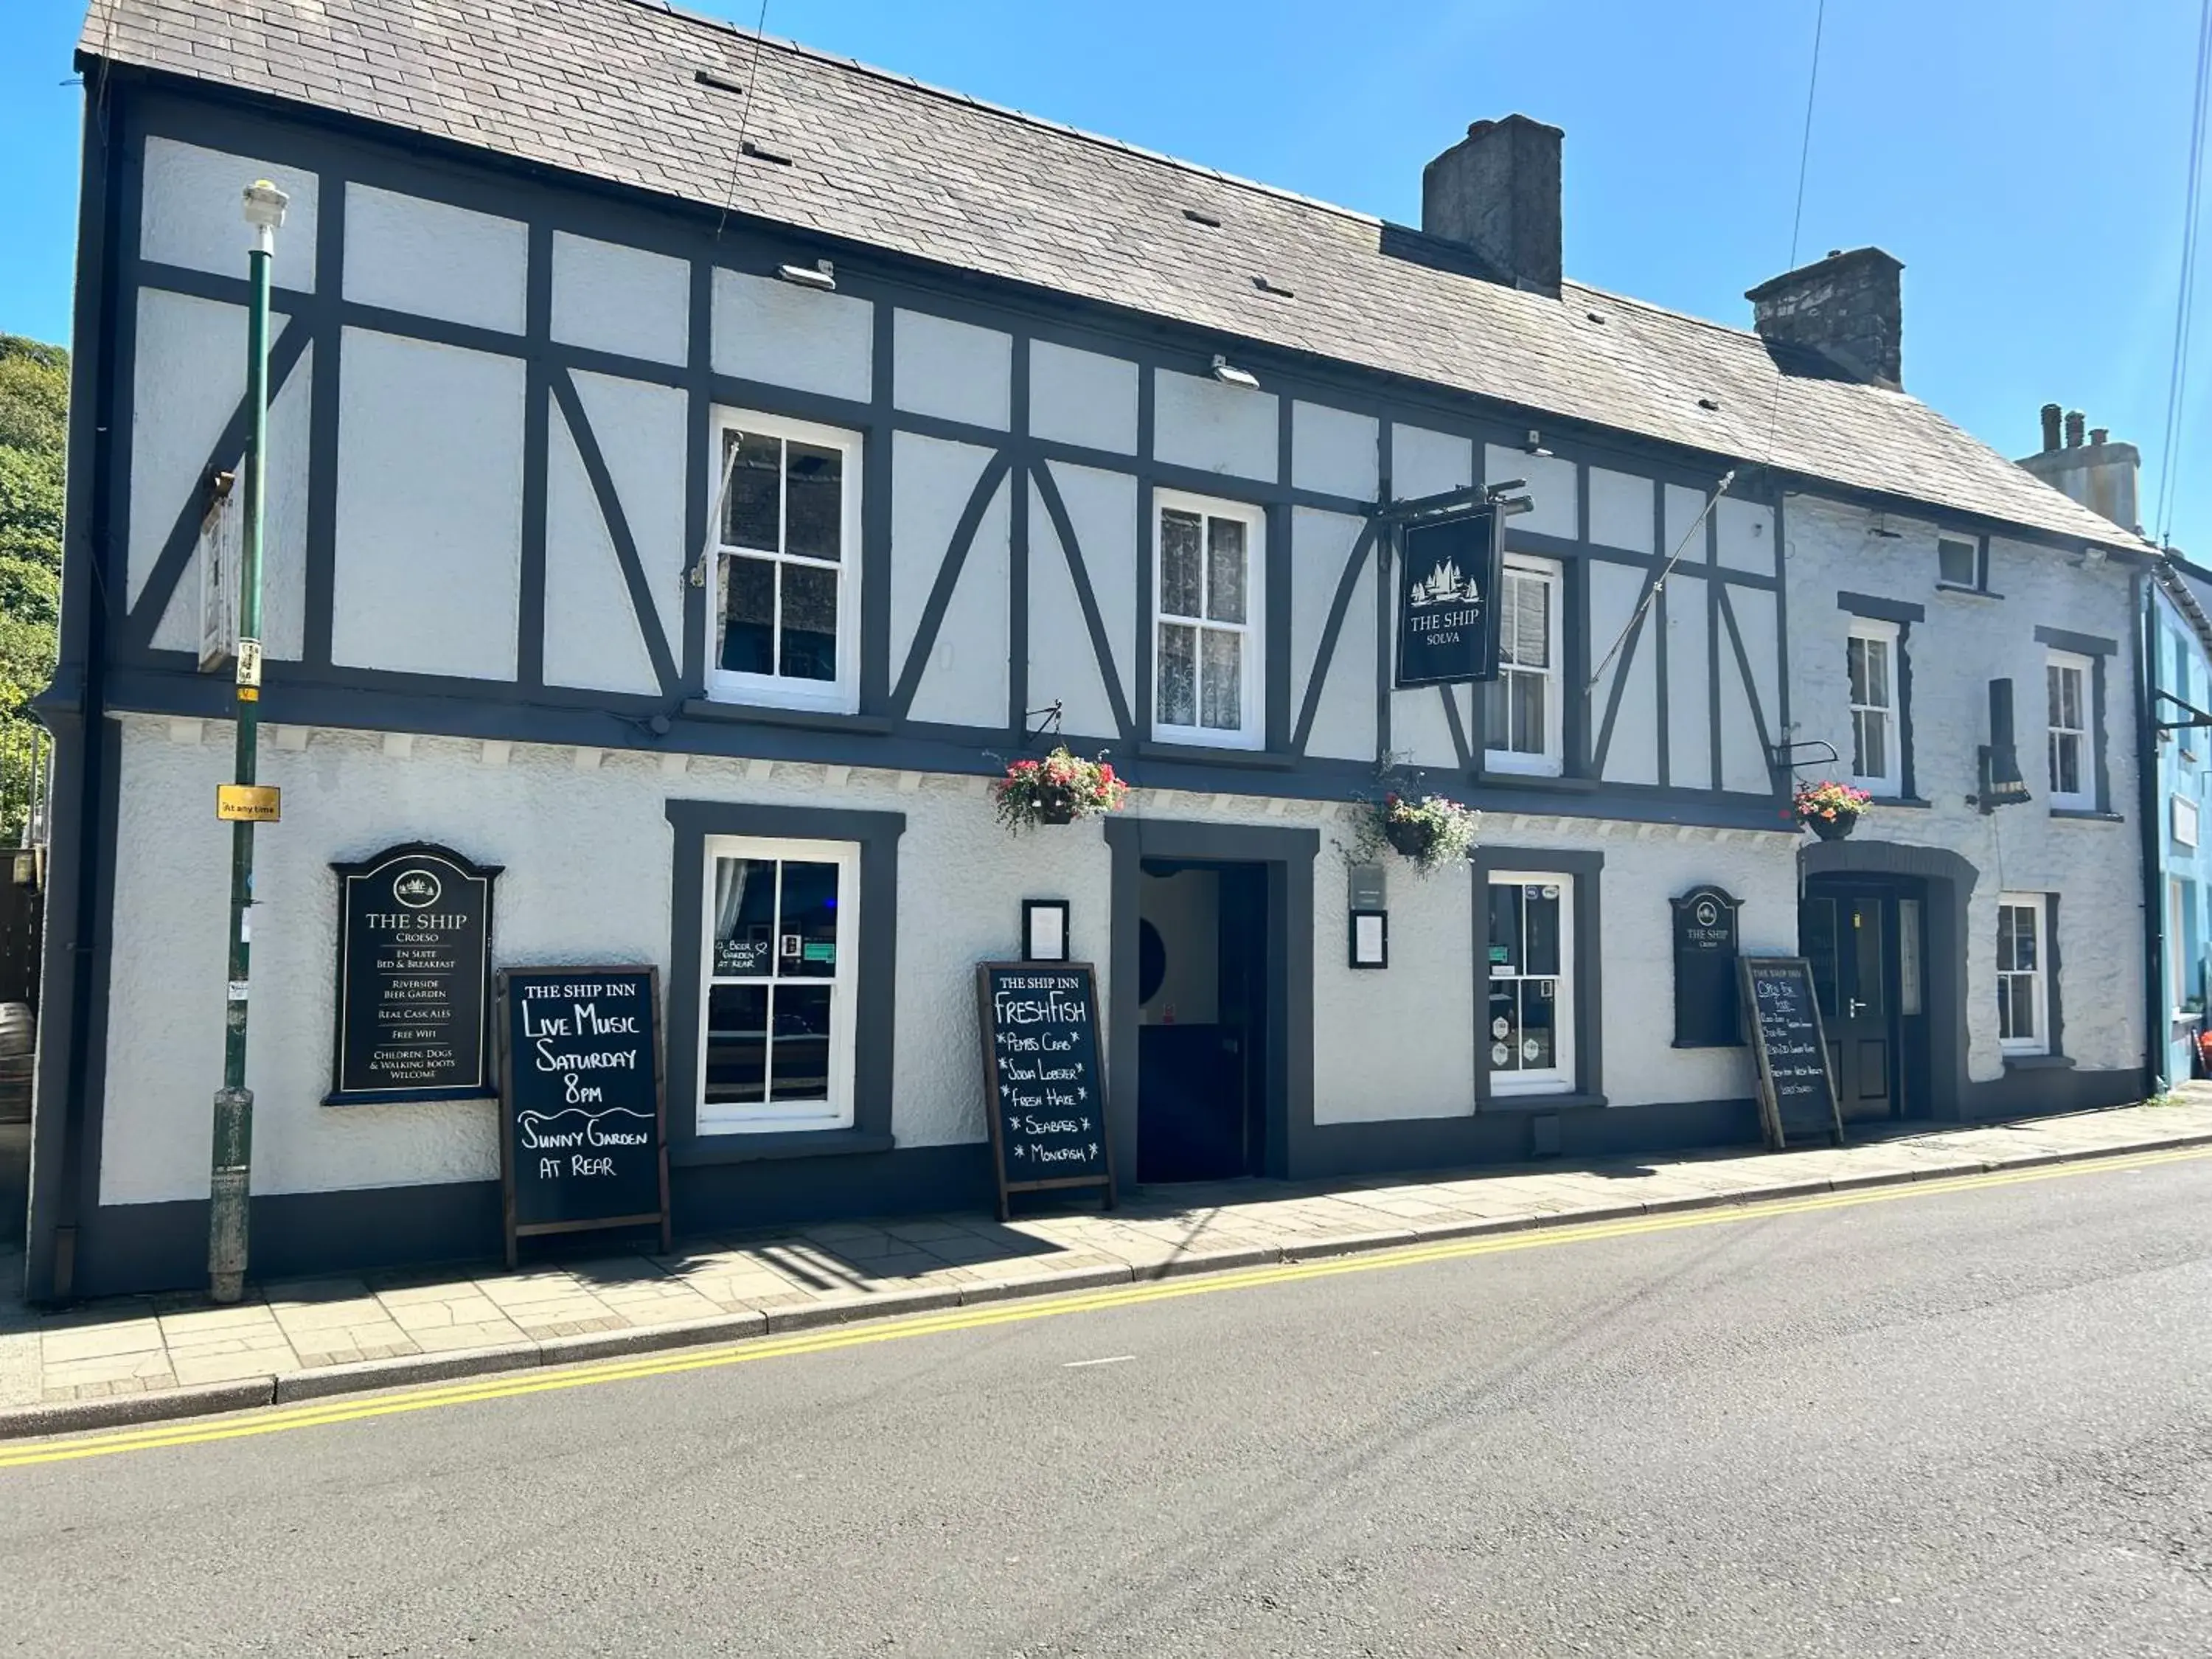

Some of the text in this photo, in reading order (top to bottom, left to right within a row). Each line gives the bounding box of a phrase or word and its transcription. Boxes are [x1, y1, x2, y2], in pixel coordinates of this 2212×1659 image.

[1411, 608, 1479, 632] THE SHIP
[1427, 632, 1460, 645] SOLVA
[223, 804, 235, 812] At
[236, 805, 253, 813] any
[366, 914, 467, 930] THE SHIP
[396, 933, 439, 942] CROESO
[1687, 928, 1706, 939] THE
[377, 960, 456, 968] BED & BREAKFAST
[393, 980, 439, 989] RIVERSIDE
[999, 977, 1079, 989] THE SHIP INN
[384, 990, 446, 998] BEER GARDEN
[524, 984, 636, 999] THE SHIP INN
[995, 990, 1086, 1024] FRESH FISH
[378, 1011, 401, 1019] REAL
[404, 1010, 428, 1018] CASK
[522, 999, 641, 1037] LIVE MUSIC
[392, 1030, 413, 1039] FREE
[427, 1049, 453, 1058] DOGS
[536, 1037, 637, 1071] SATURDAY
[369, 1061, 378, 1070] &
[381, 1061, 424, 1069] WALKING
[391, 1070, 436, 1079] WELCOME
[521, 1117, 648, 1149] SUNNY GARDEN
[540, 1154, 617, 1179] AT REAR
